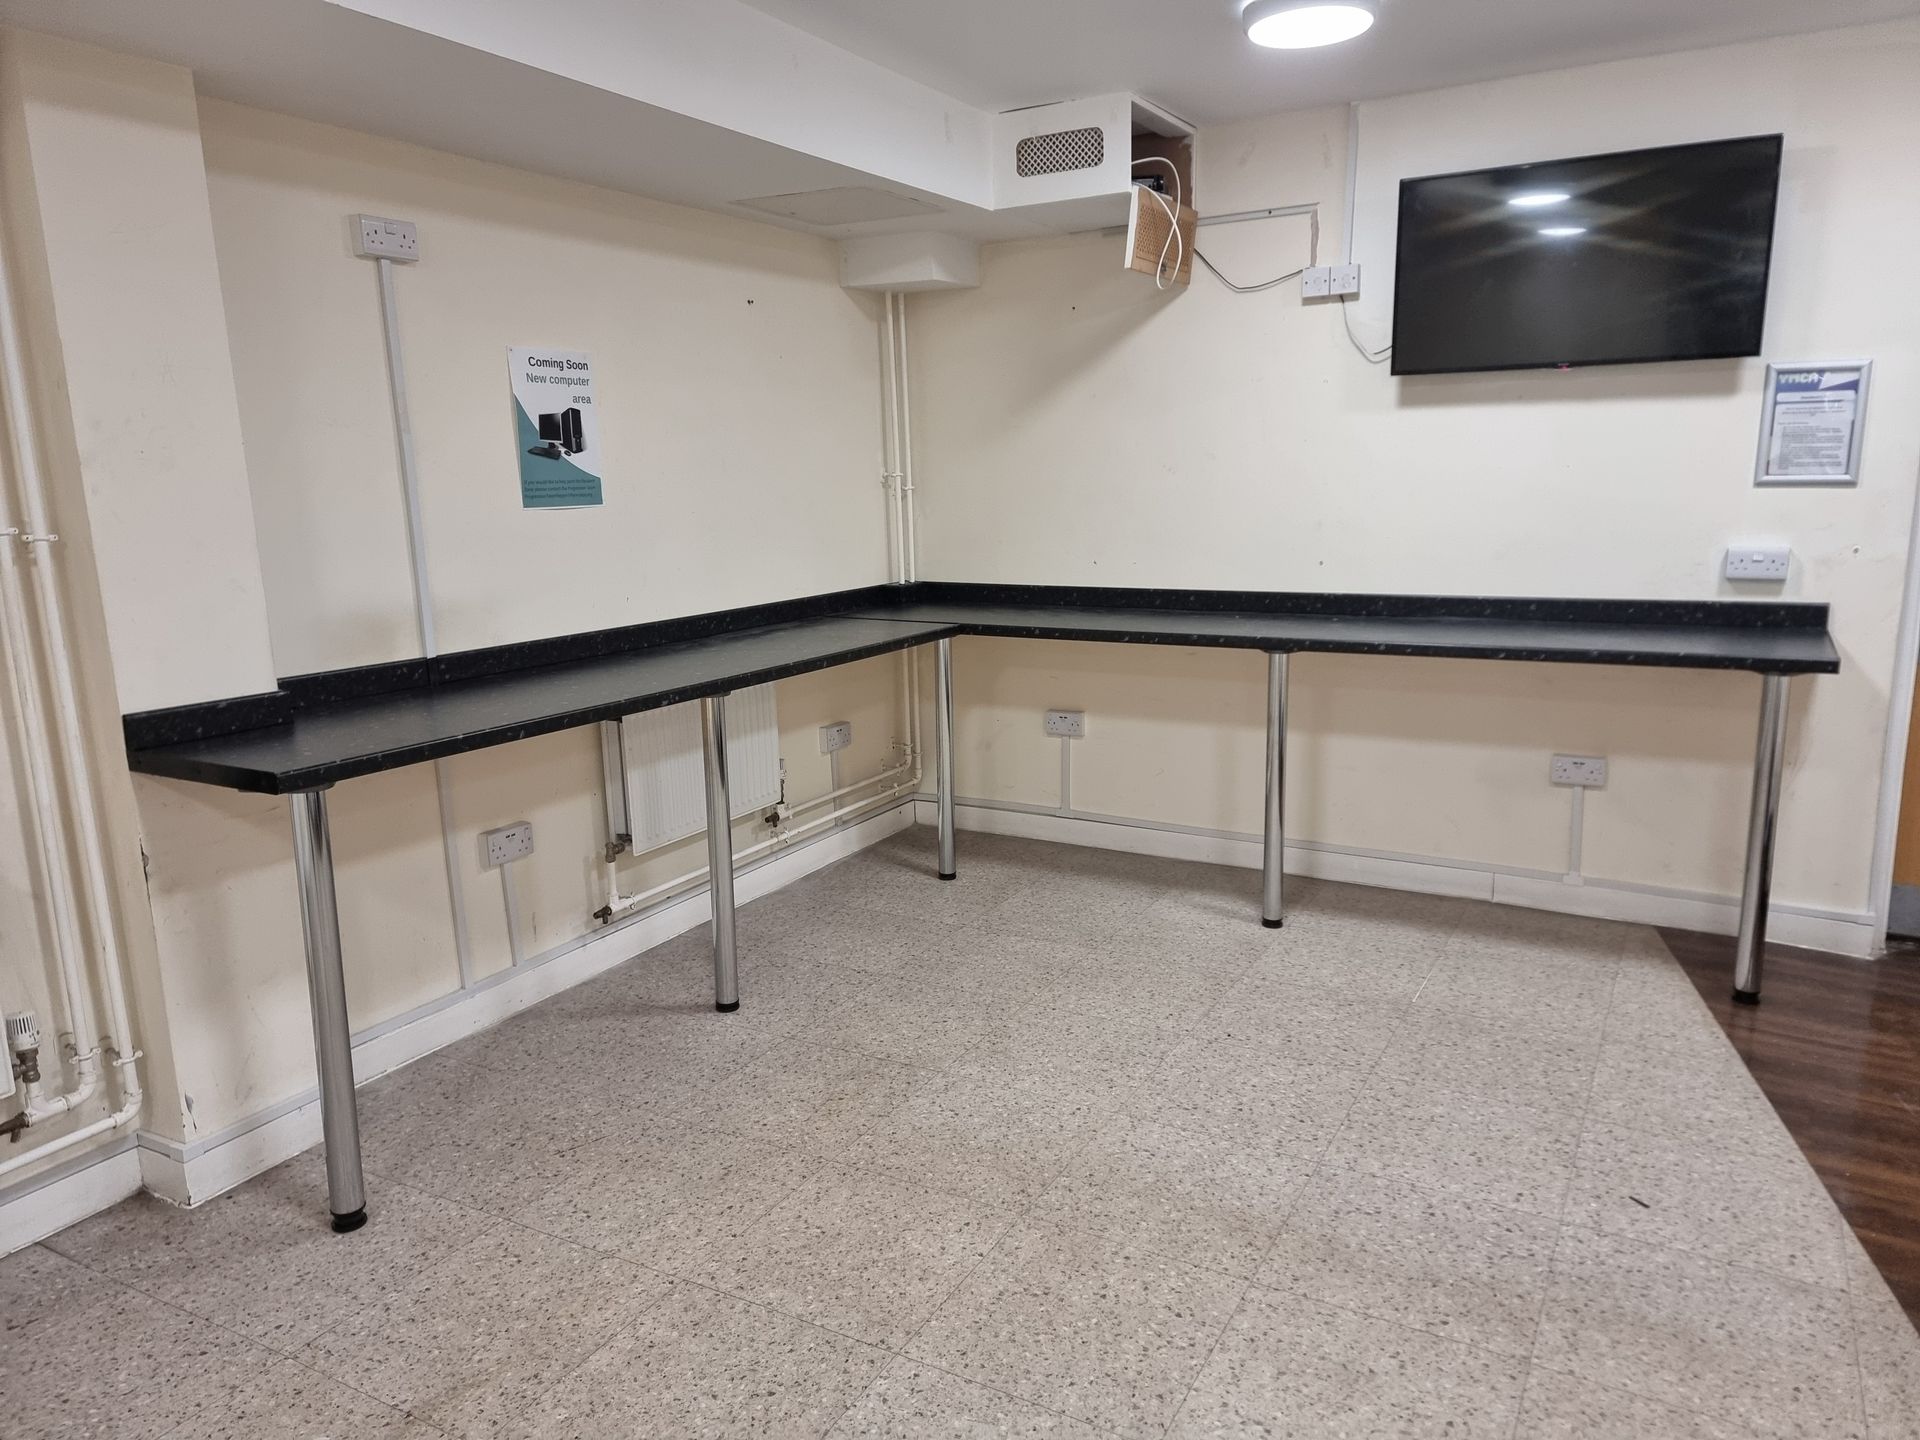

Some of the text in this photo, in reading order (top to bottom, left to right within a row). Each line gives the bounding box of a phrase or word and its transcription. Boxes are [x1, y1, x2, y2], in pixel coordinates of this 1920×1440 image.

[528, 356, 589, 371] Coming Soon
[526, 372, 590, 387] New computer
[572, 395, 592, 404] area
